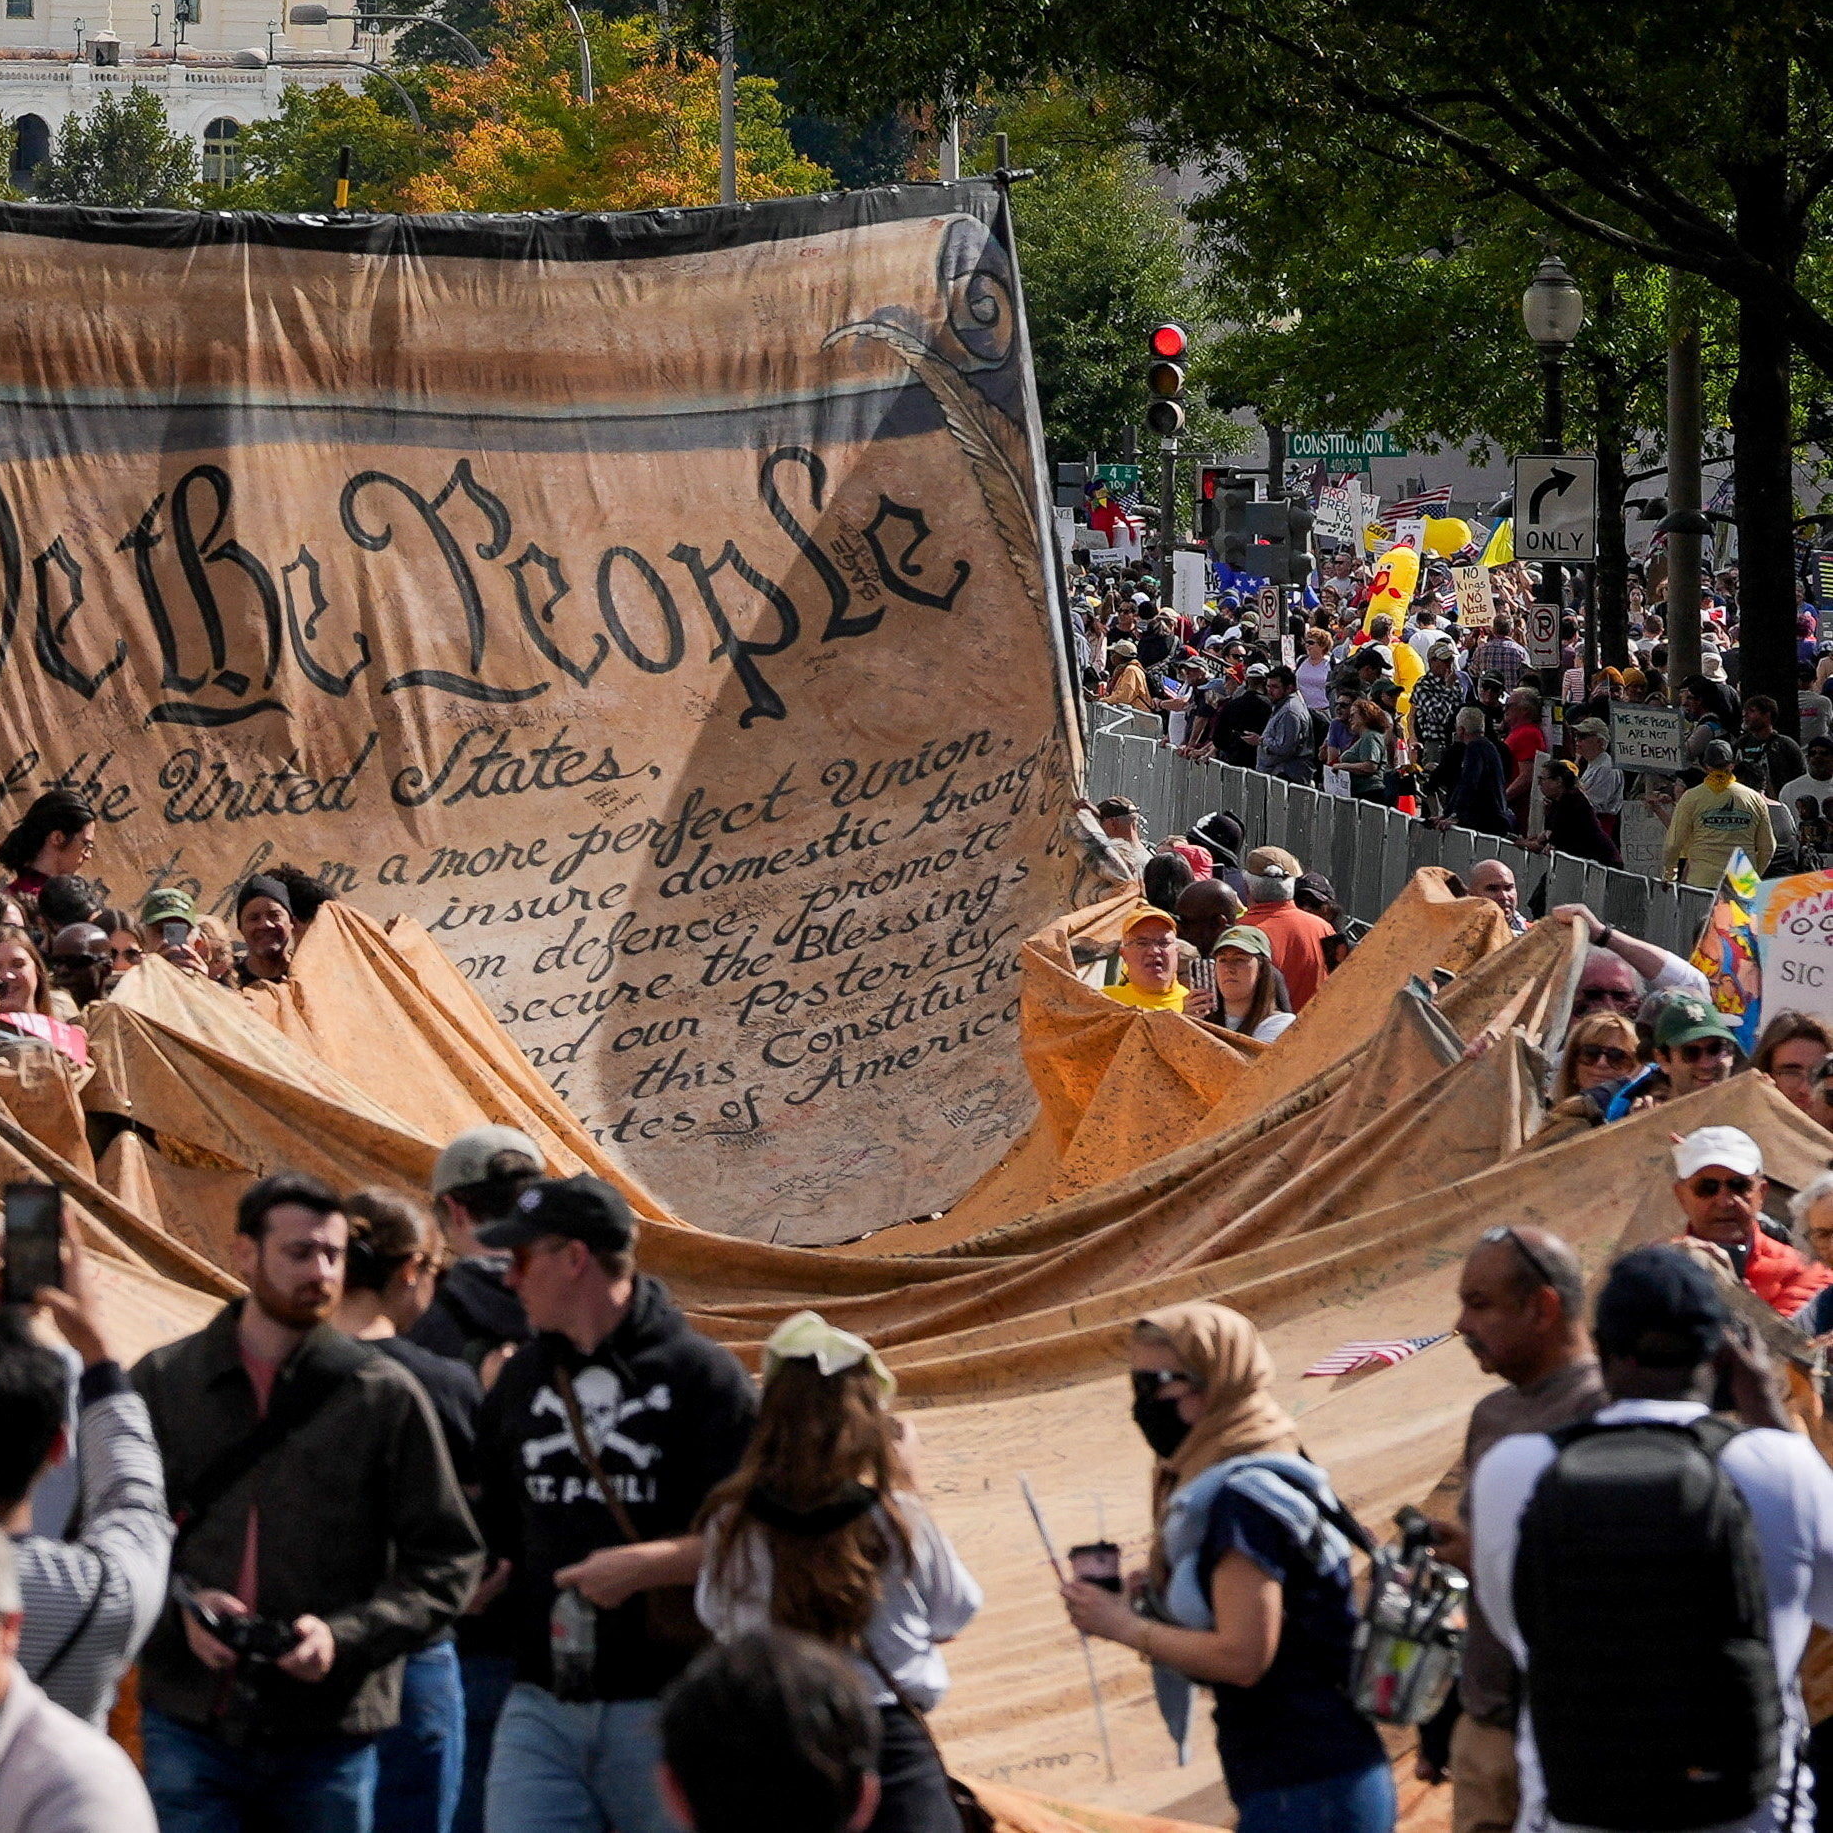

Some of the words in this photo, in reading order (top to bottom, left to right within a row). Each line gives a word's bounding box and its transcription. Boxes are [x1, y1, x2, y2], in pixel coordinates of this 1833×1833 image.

[1293, 433, 1383, 455] CONSTITUTION
[1321, 498, 1373, 517] FREEM
[1322, 487, 1375, 505] PROCT
[1526, 531, 1584, 551] ONLY
[1463, 567, 1479, 579] NO
[340, 446, 972, 729] People
[1457, 581, 1486, 594] Kings
[1467, 592, 1484, 604] NO
[1617, 741, 1635, 755] THE
[1628, 729, 1646, 739] ARE
[1649, 730, 1668, 740] NOT
[160, 732, 379, 827] United
[417, 839, 553, 886] more
[550, 767, 798, 884] perfect
[429, 883, 626, 935] insure
[660, 818, 892, 900] domestic
[774, 820, 1009, 946] promote
[498, 974, 673, 1026] secure
[702, 936, 777, 987] the
[790, 862, 1031, 965] Blessings
[1780, 960, 1825, 987] SIC
[612, 1013, 703, 1051] our
[634, 1048, 736, 1101] this
[700, 1081, 764, 1134] of
[785, 997, 1022, 1107] America
